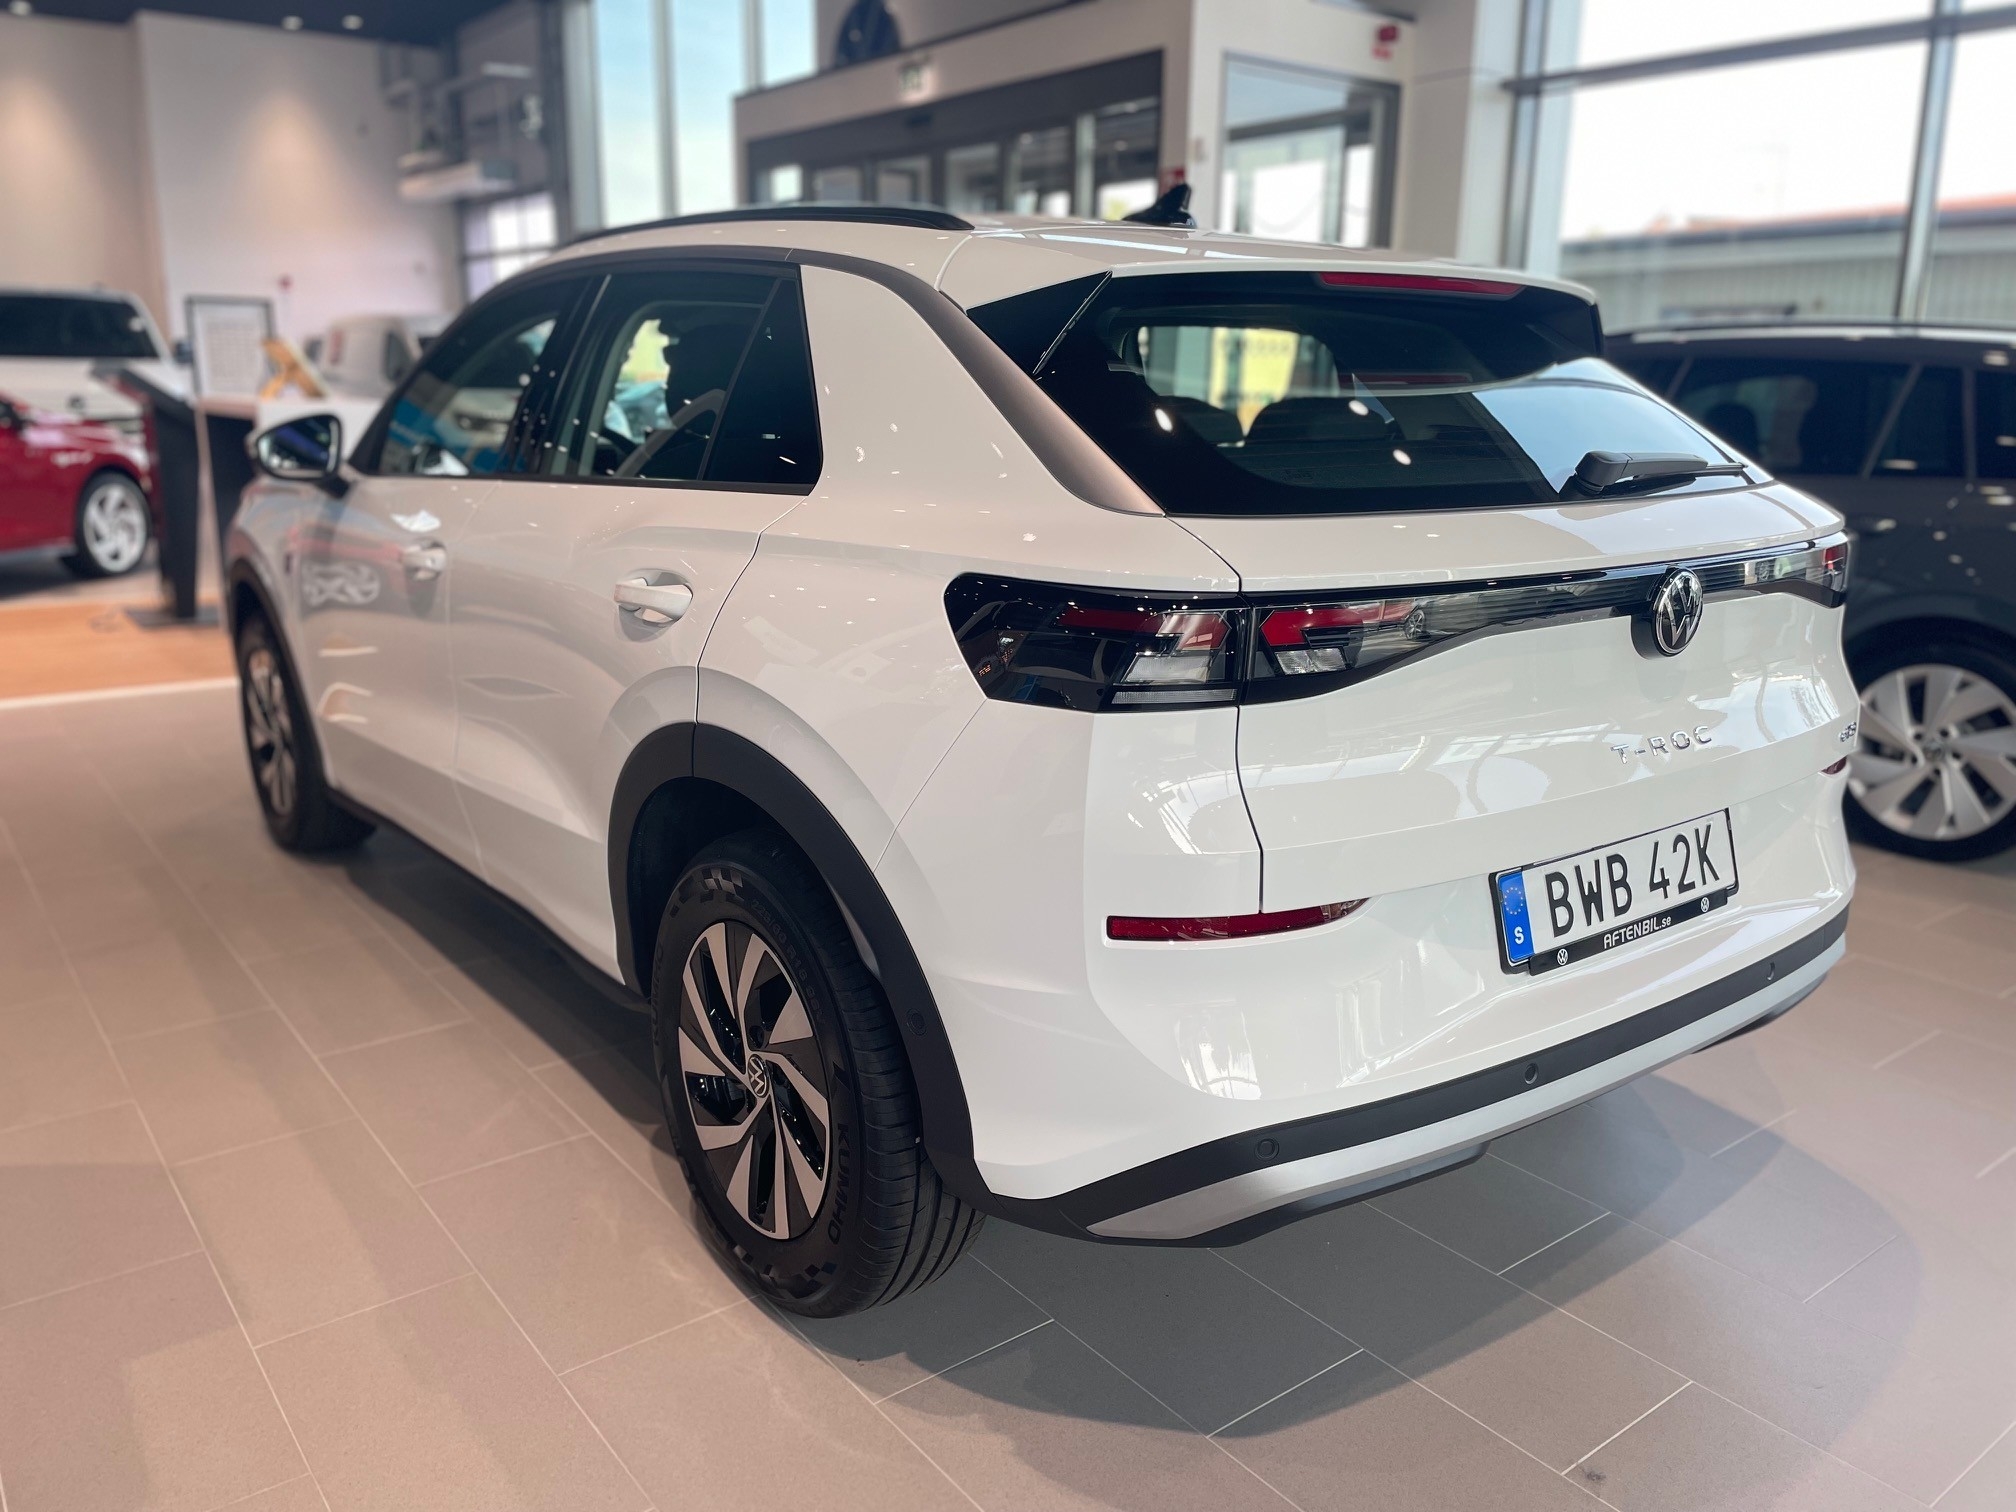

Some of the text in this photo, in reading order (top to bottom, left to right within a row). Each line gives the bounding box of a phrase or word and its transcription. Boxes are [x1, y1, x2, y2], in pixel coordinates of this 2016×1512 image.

[1611, 726, 1712, 764] T-ROC
[1545, 823, 1720, 938] BWB 42K
[1514, 926, 1525, 944] S
[1603, 915, 1672, 950] AFTENBIL.se
[828, 1123, 850, 1245] KUMHO
